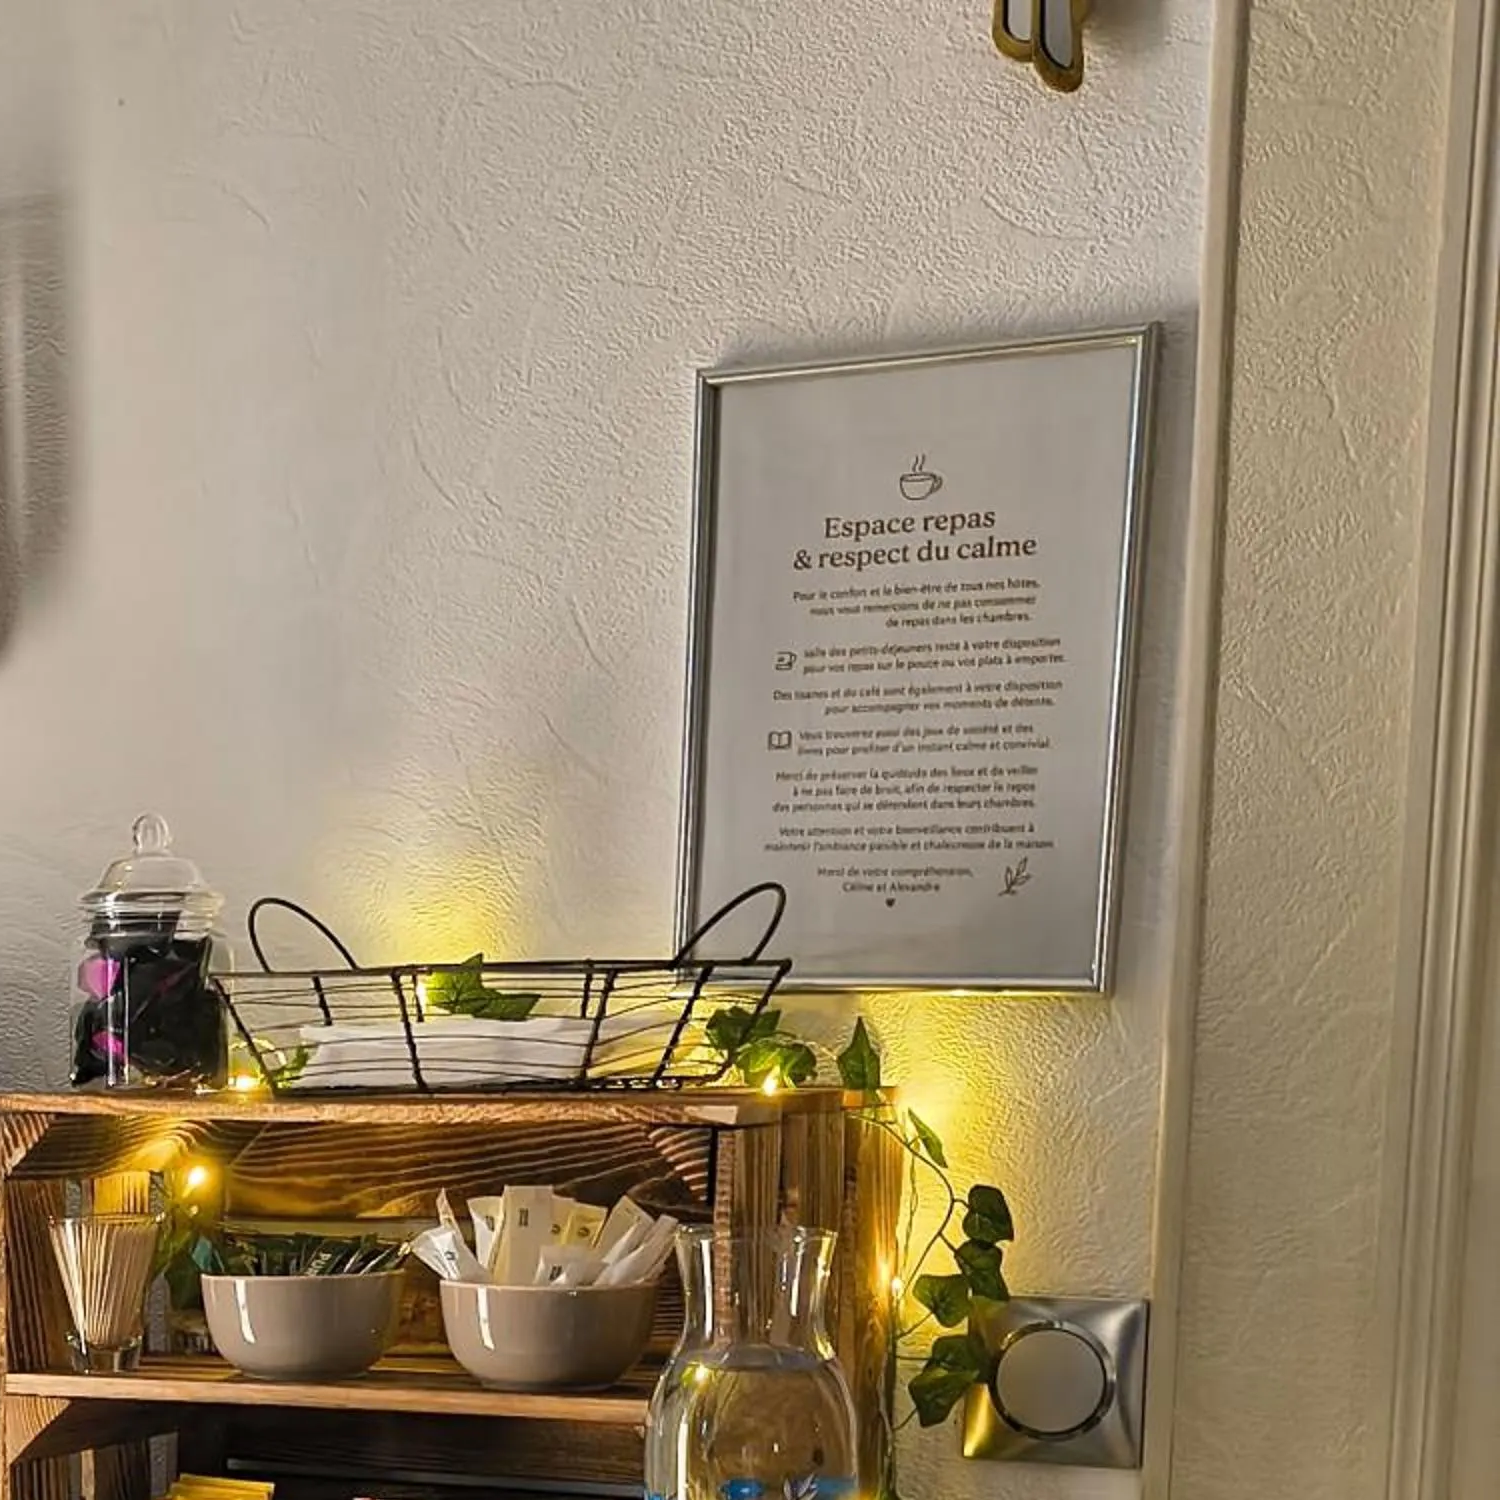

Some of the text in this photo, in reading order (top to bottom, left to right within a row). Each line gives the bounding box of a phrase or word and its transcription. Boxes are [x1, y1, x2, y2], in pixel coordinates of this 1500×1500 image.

[824, 511, 997, 543] Espace repas
[793, 535, 1038, 573] & respect du calme
